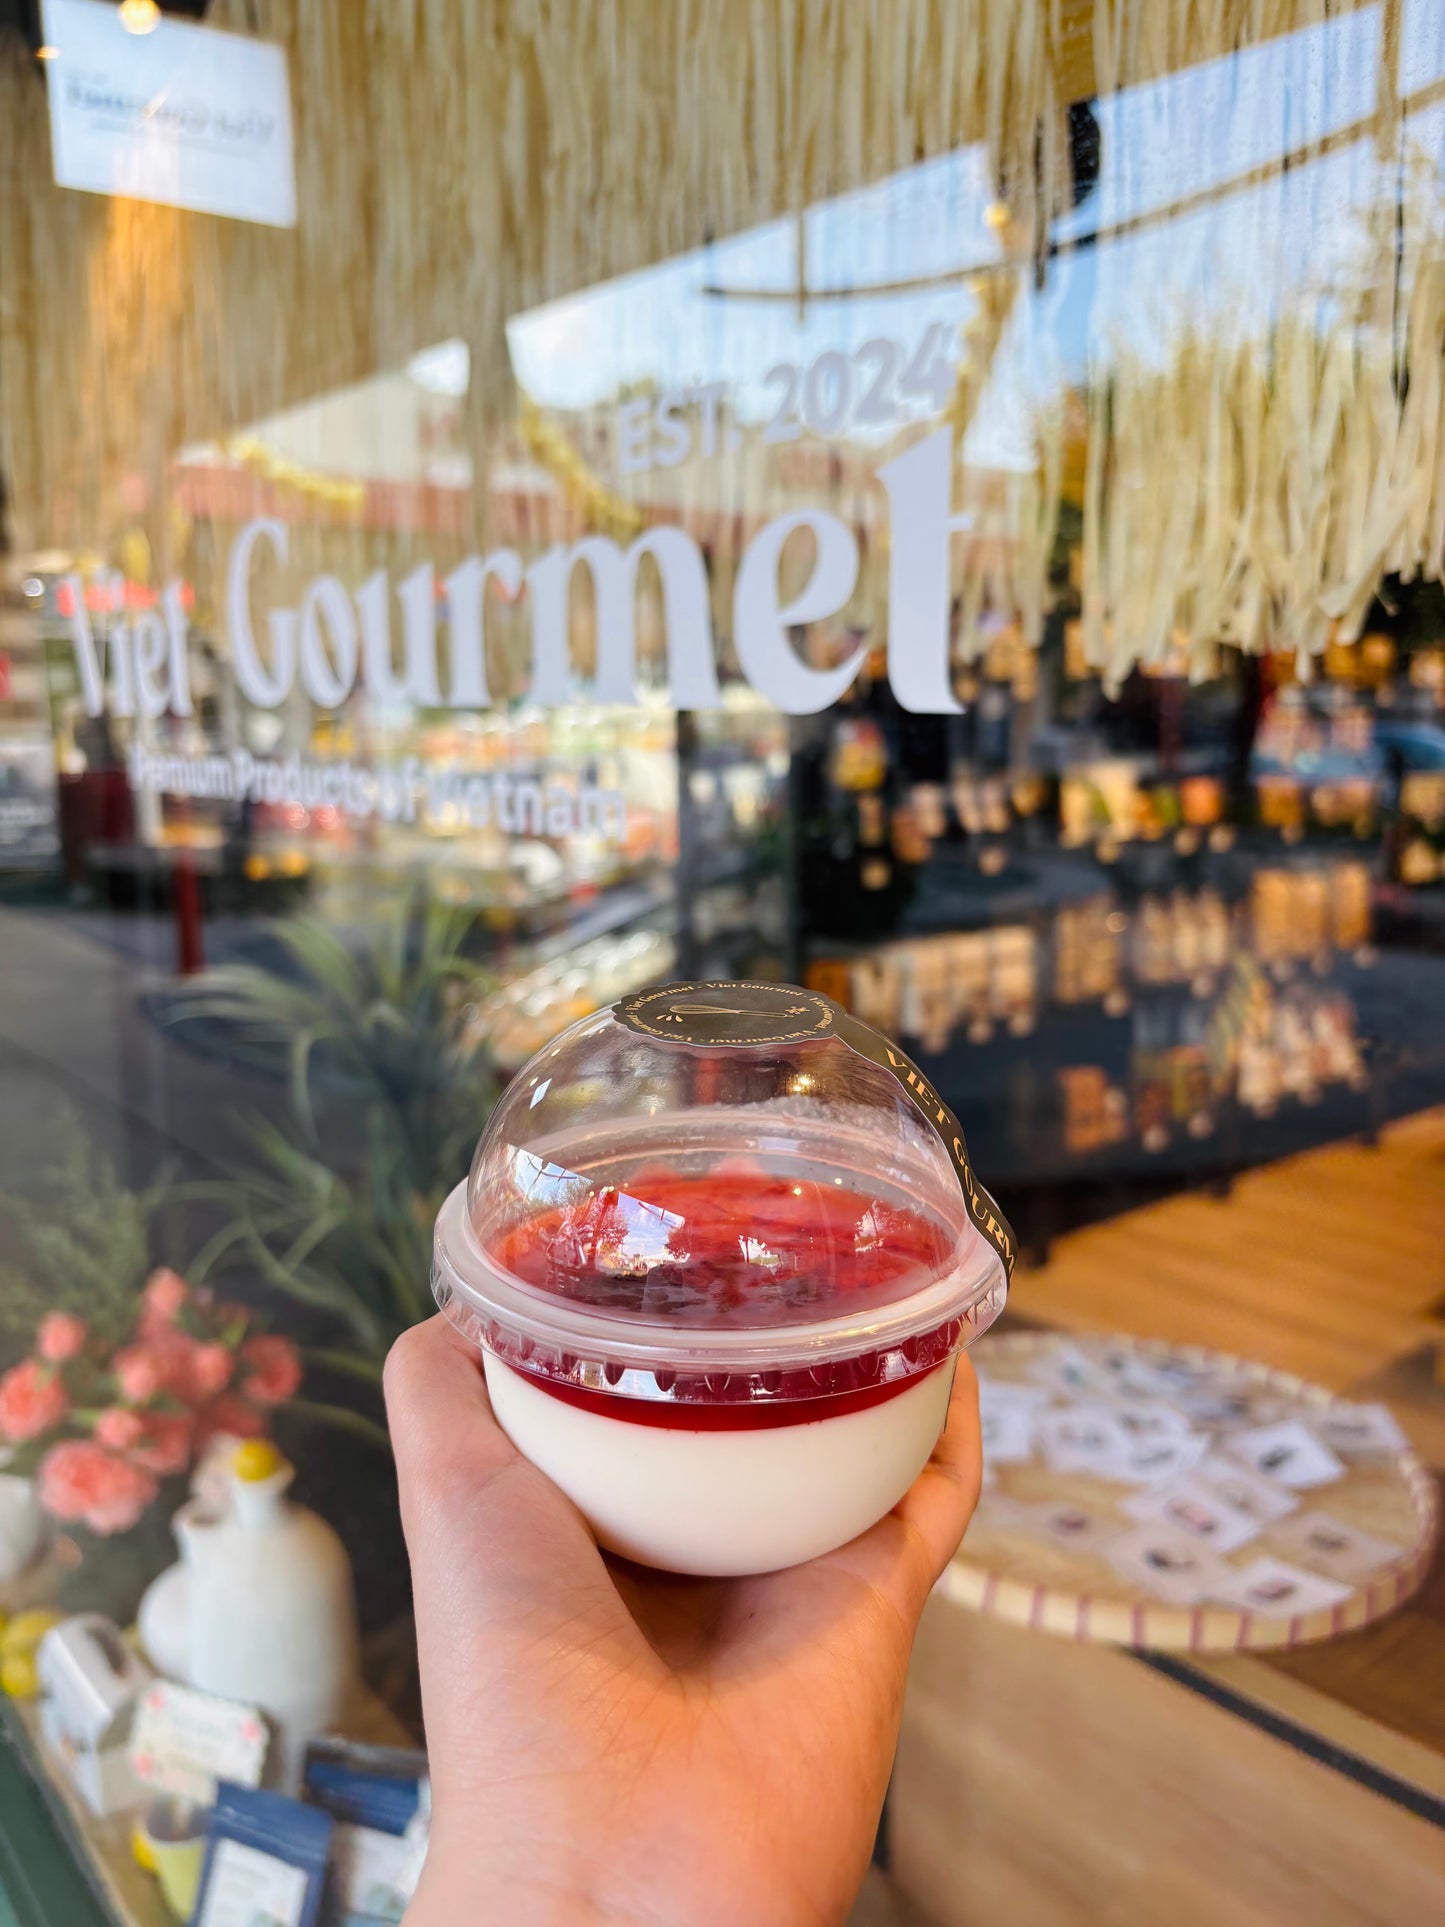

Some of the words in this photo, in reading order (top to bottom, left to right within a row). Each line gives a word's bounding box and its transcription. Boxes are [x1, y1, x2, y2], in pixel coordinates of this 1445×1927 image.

[621, 381, 743, 474] EST.
[764, 322, 958, 445] 2024
[64, 568, 193, 718] Viet
[229, 424, 973, 715] Gourmet
[130, 744, 232, 796] Premium
[232, 747, 374, 817] Products
[425, 764, 628, 843] Vietnam
[740, 983, 805, 996] Gourmet
[886, 1048, 951, 1125] VIET
